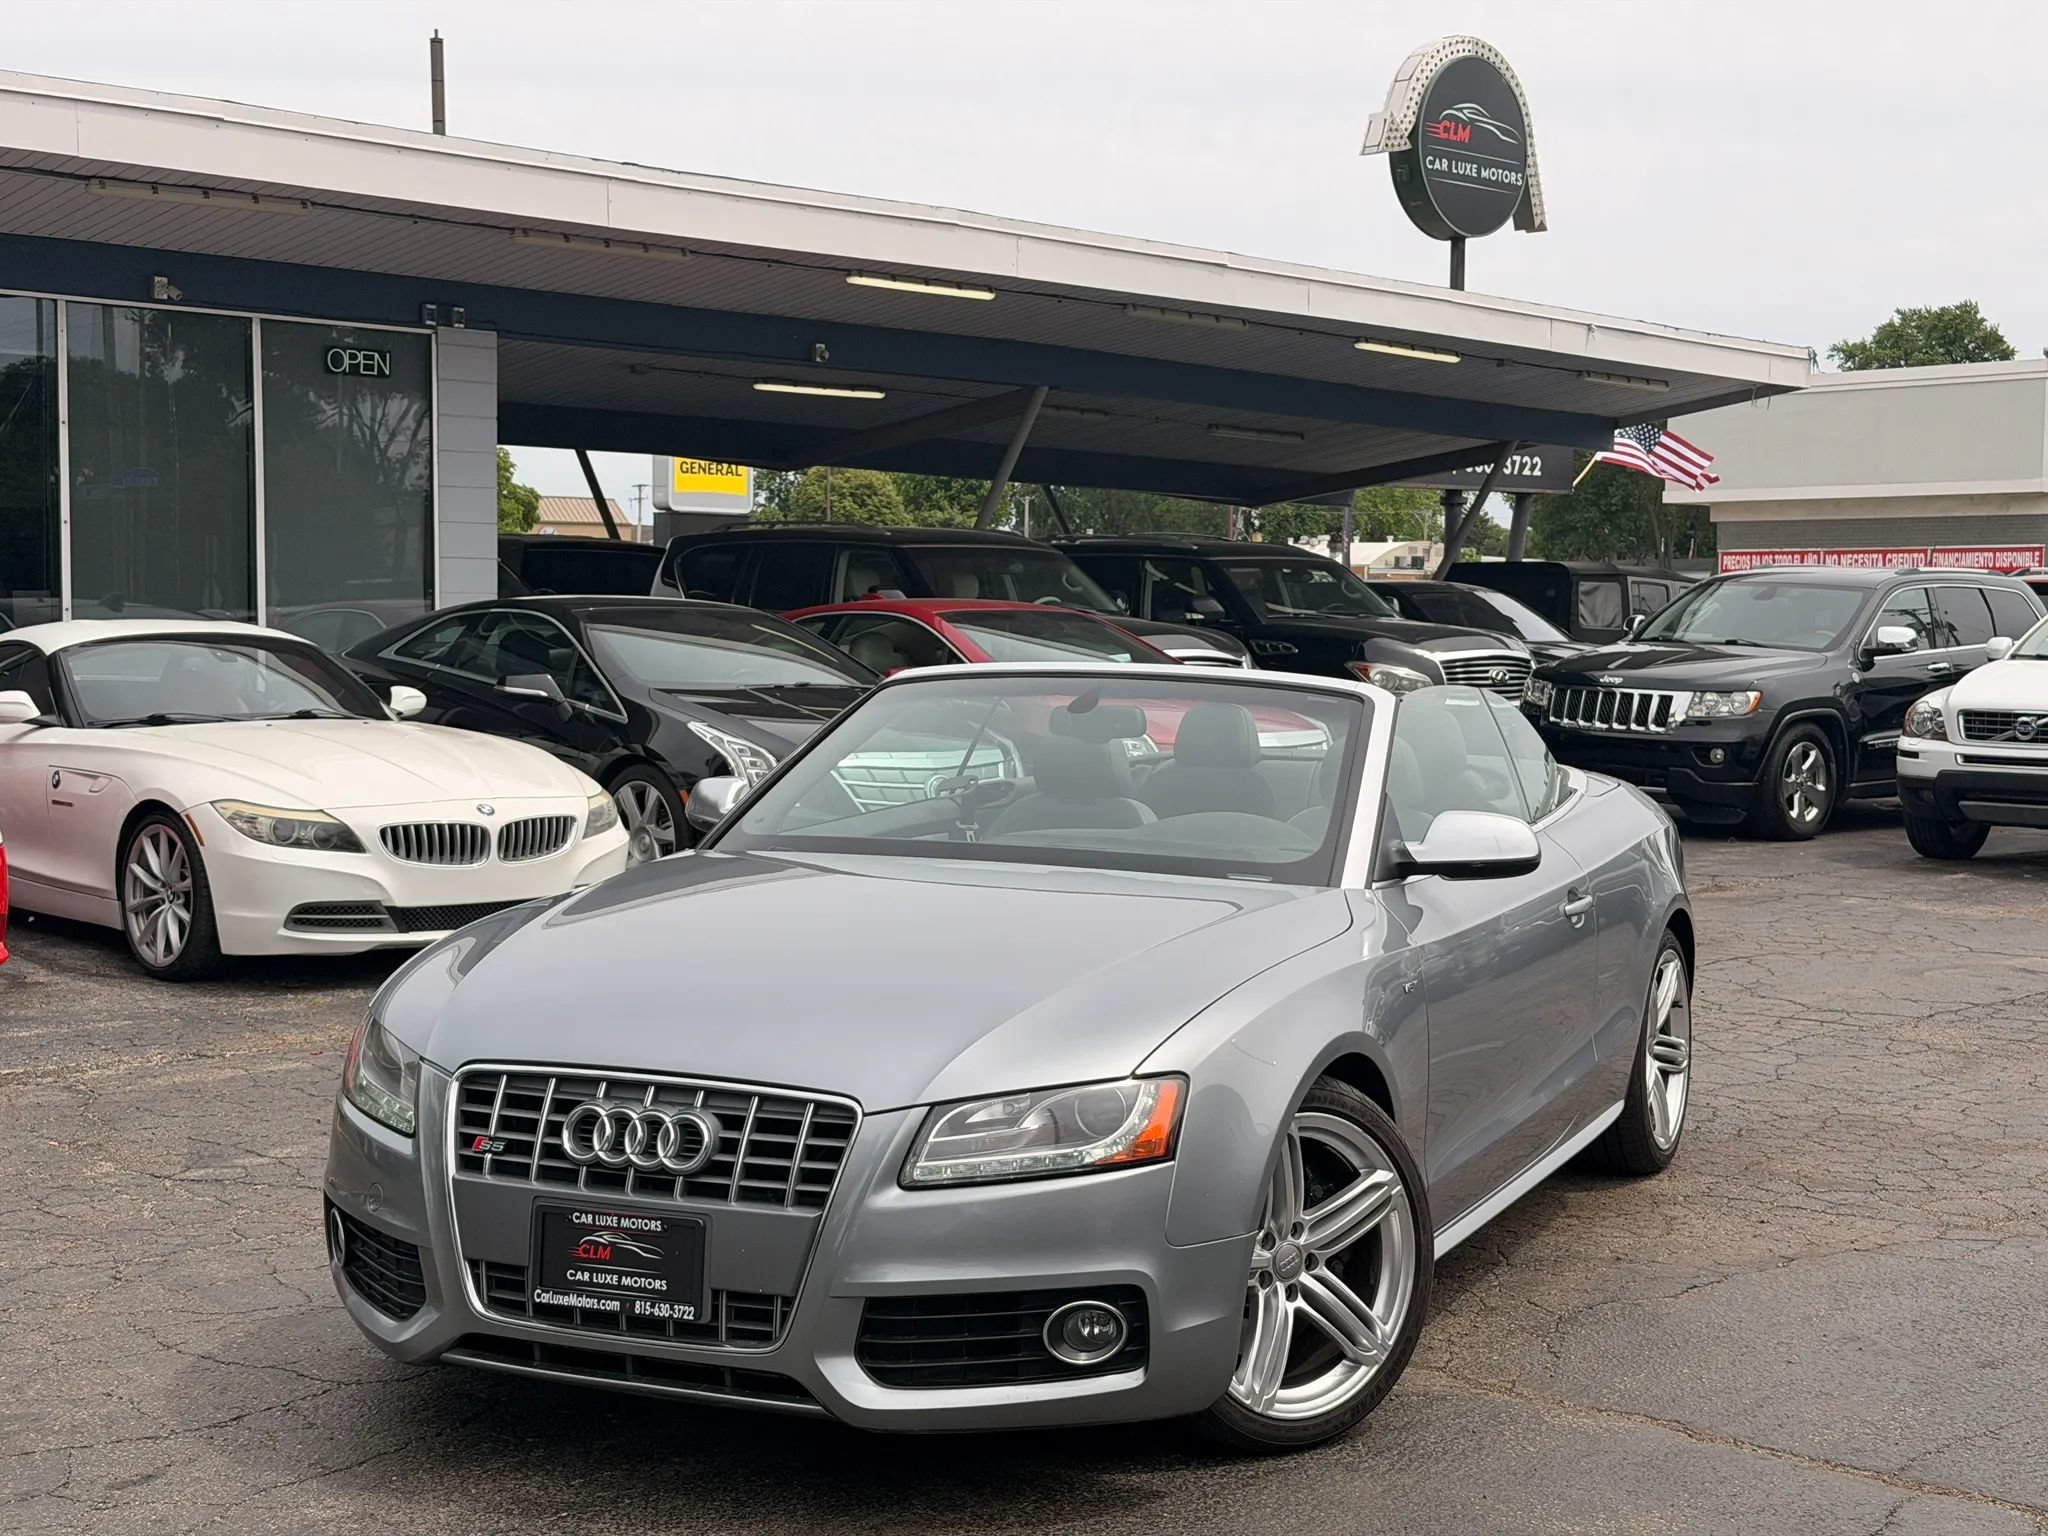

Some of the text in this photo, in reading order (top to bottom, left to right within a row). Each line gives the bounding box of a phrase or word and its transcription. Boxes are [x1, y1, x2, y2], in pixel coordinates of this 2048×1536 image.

[1439, 120, 1472, 144] CLM
[1426, 155, 1523, 186] CAR LUXE MOTORS
[327, 348, 390, 376] OPEN
[680, 461, 743, 477] GENERAL
[1723, 555, 1751, 570] PRECIOS
[1826, 552, 1925, 568] NO NECESITA CREDITO
[1932, 551, 2040, 568] FINANCIAMIENTO DISPONIBLE
[1599, 674, 1624, 685] Jeep
[479, 1139, 506, 1152] S5
[572, 1212, 663, 1232] CAR LUXE MOTORS
[578, 1245, 612, 1261] CLM
[566, 1269, 668, 1291] CAR LUXE MOTORS
[534, 1289, 695, 1320] CarLuxeMotors.com 815-630-3722
